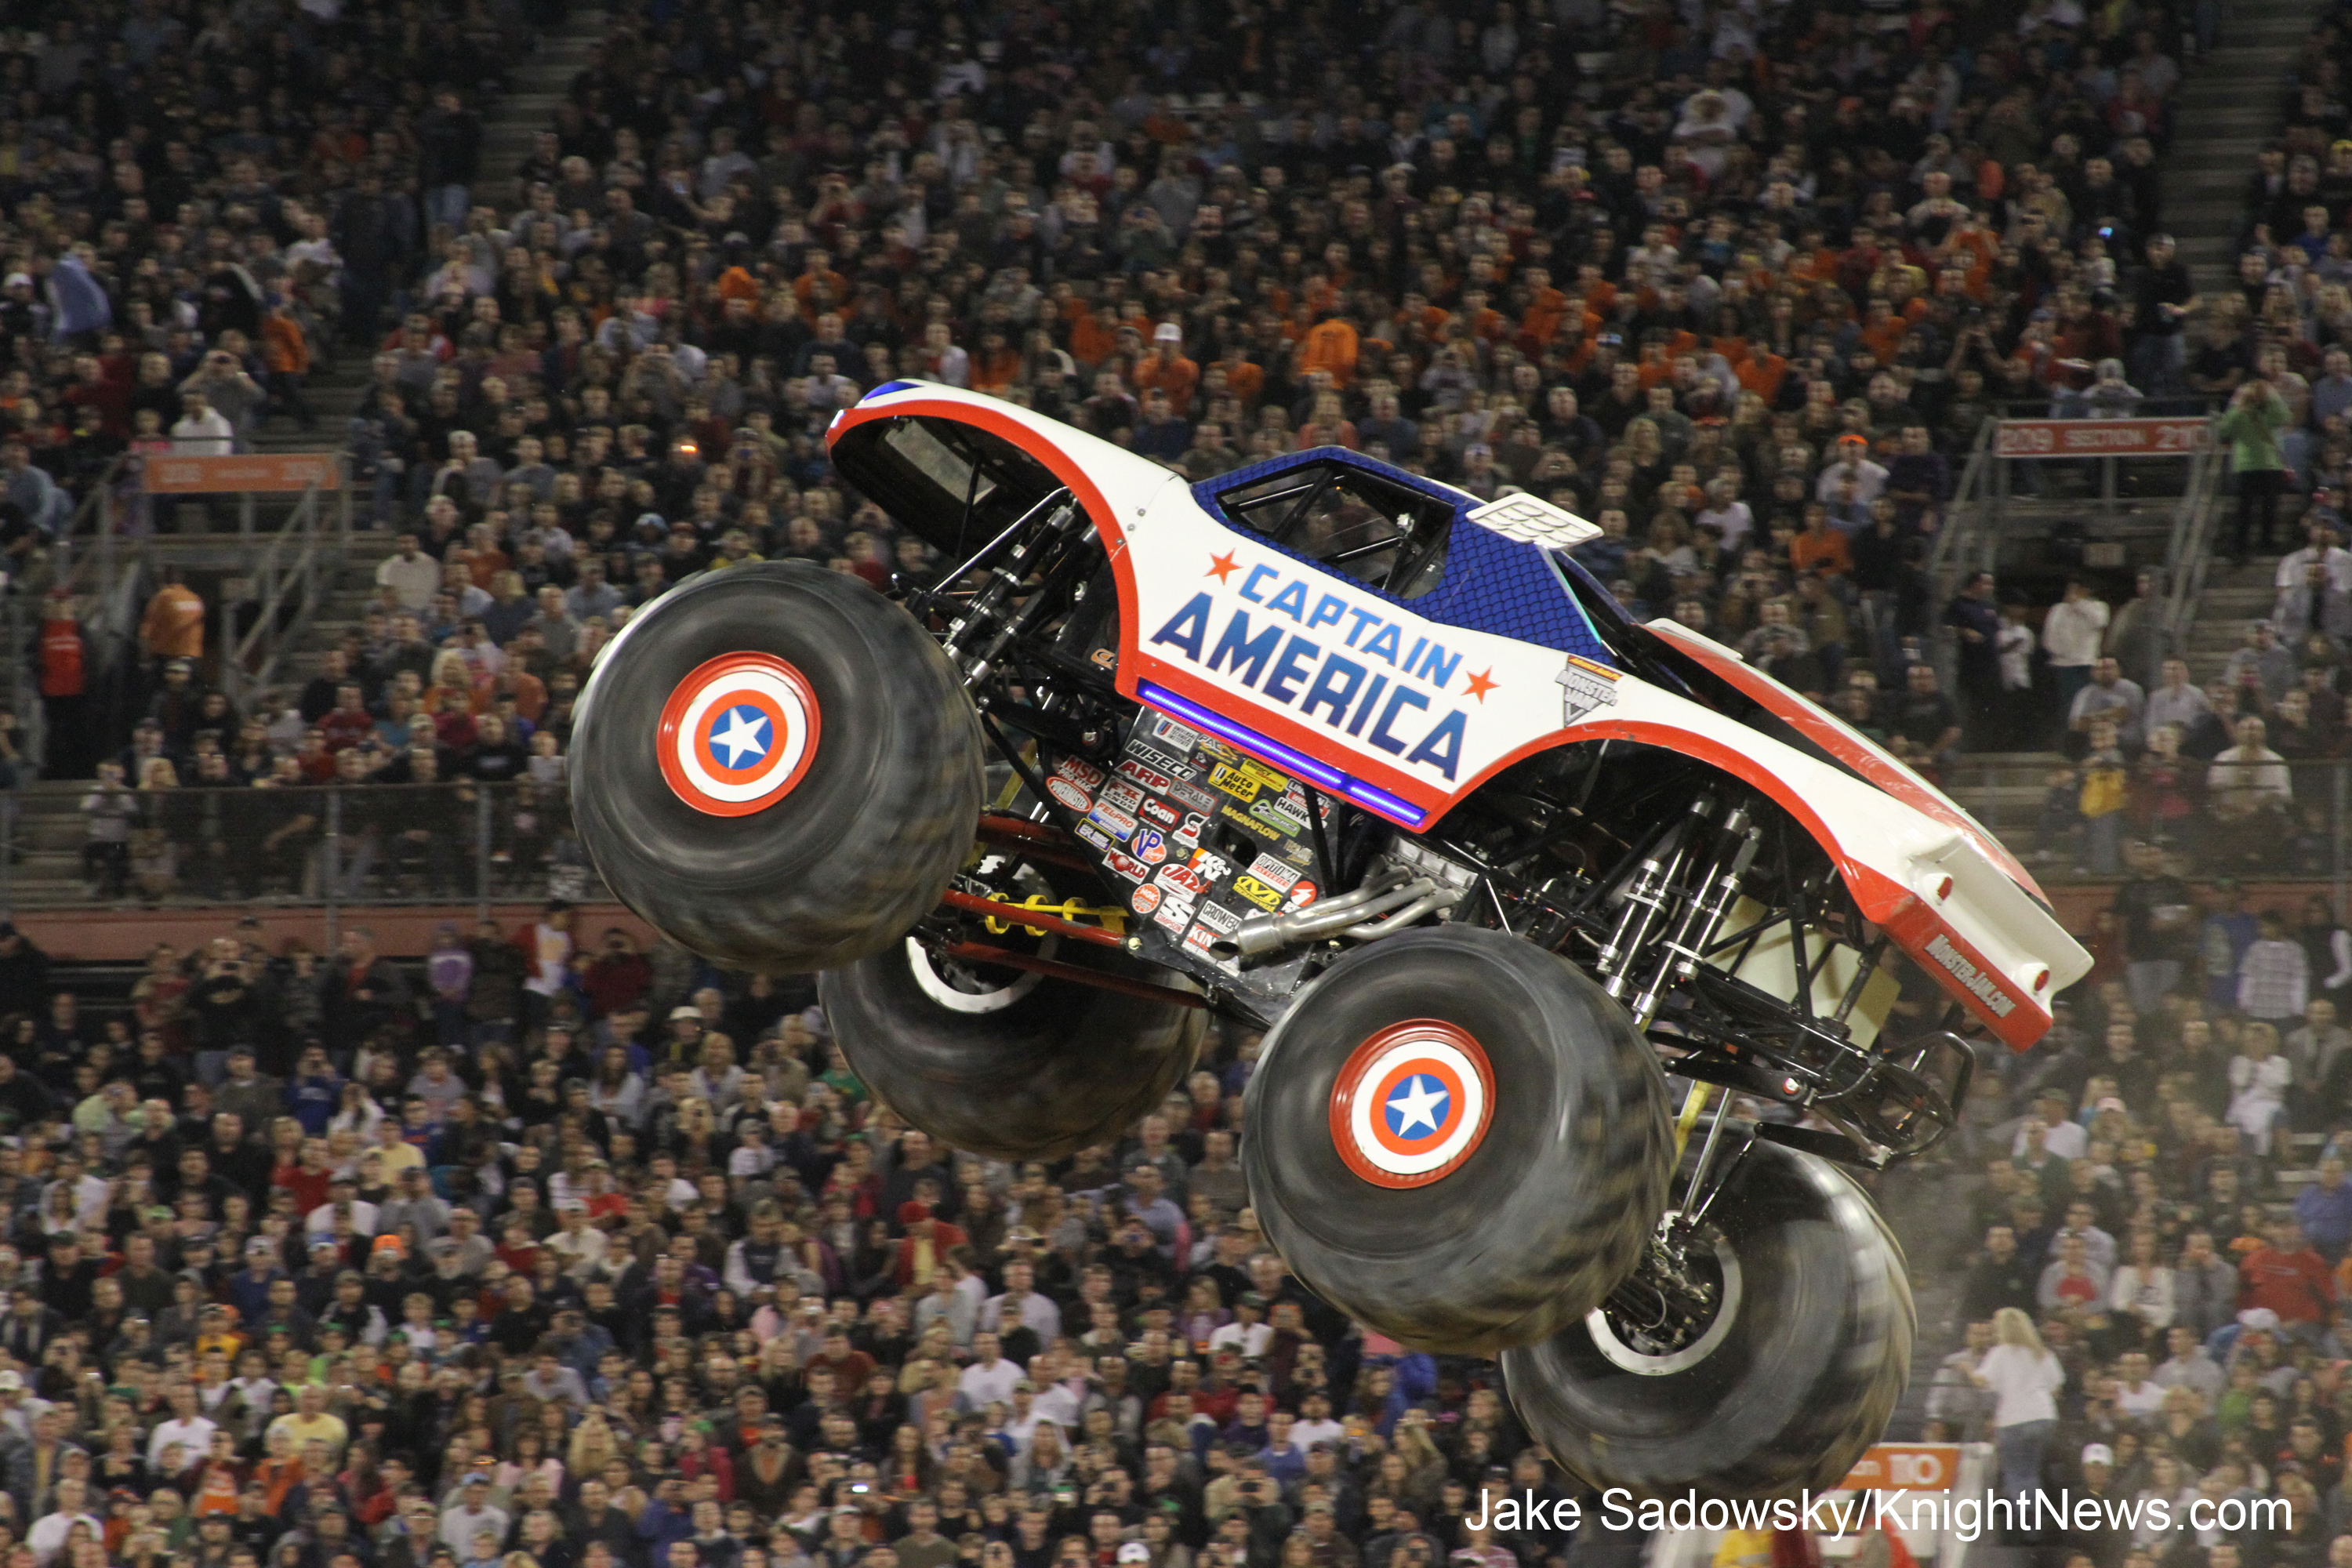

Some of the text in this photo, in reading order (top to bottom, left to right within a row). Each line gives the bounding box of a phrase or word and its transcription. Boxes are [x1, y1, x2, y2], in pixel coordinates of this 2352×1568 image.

[1239, 563, 1464, 688] CAPTAIN
[1149, 591, 1468, 783] AMERICA
[1555, 670, 1617, 706] MONSTER
[1565, 688, 1597, 712] JAM
[1064, 755, 1102, 785] MSD
[1116, 760, 1169, 787] ARP
[1127, 742, 1196, 780] WISECO
[1221, 778, 1254, 798] Meter
[1226, 771, 1254, 788] Auto
[1172, 781, 1212, 808] DERALE
[1098, 802, 1134, 829] FEL-PRO
[1143, 799, 1175, 824] Coan
[1221, 806, 1281, 840] MAGNAFLOW
[1277, 799, 1310, 823] HAWK
[1136, 828, 1163, 858] VP
[1107, 850, 1146, 879] WORLD
[1192, 850, 1232, 880] K&N
[1251, 864, 1290, 887] BATTERIES
[1256, 855, 1298, 883] OPTIMA
[1162, 866, 1199, 892] JAZ
[1140, 888, 1158, 901] NGK
[1155, 913, 1182, 932] SIMPSON
[1202, 902, 1240, 931] CROWER
[1189, 927, 1217, 947] KIN
